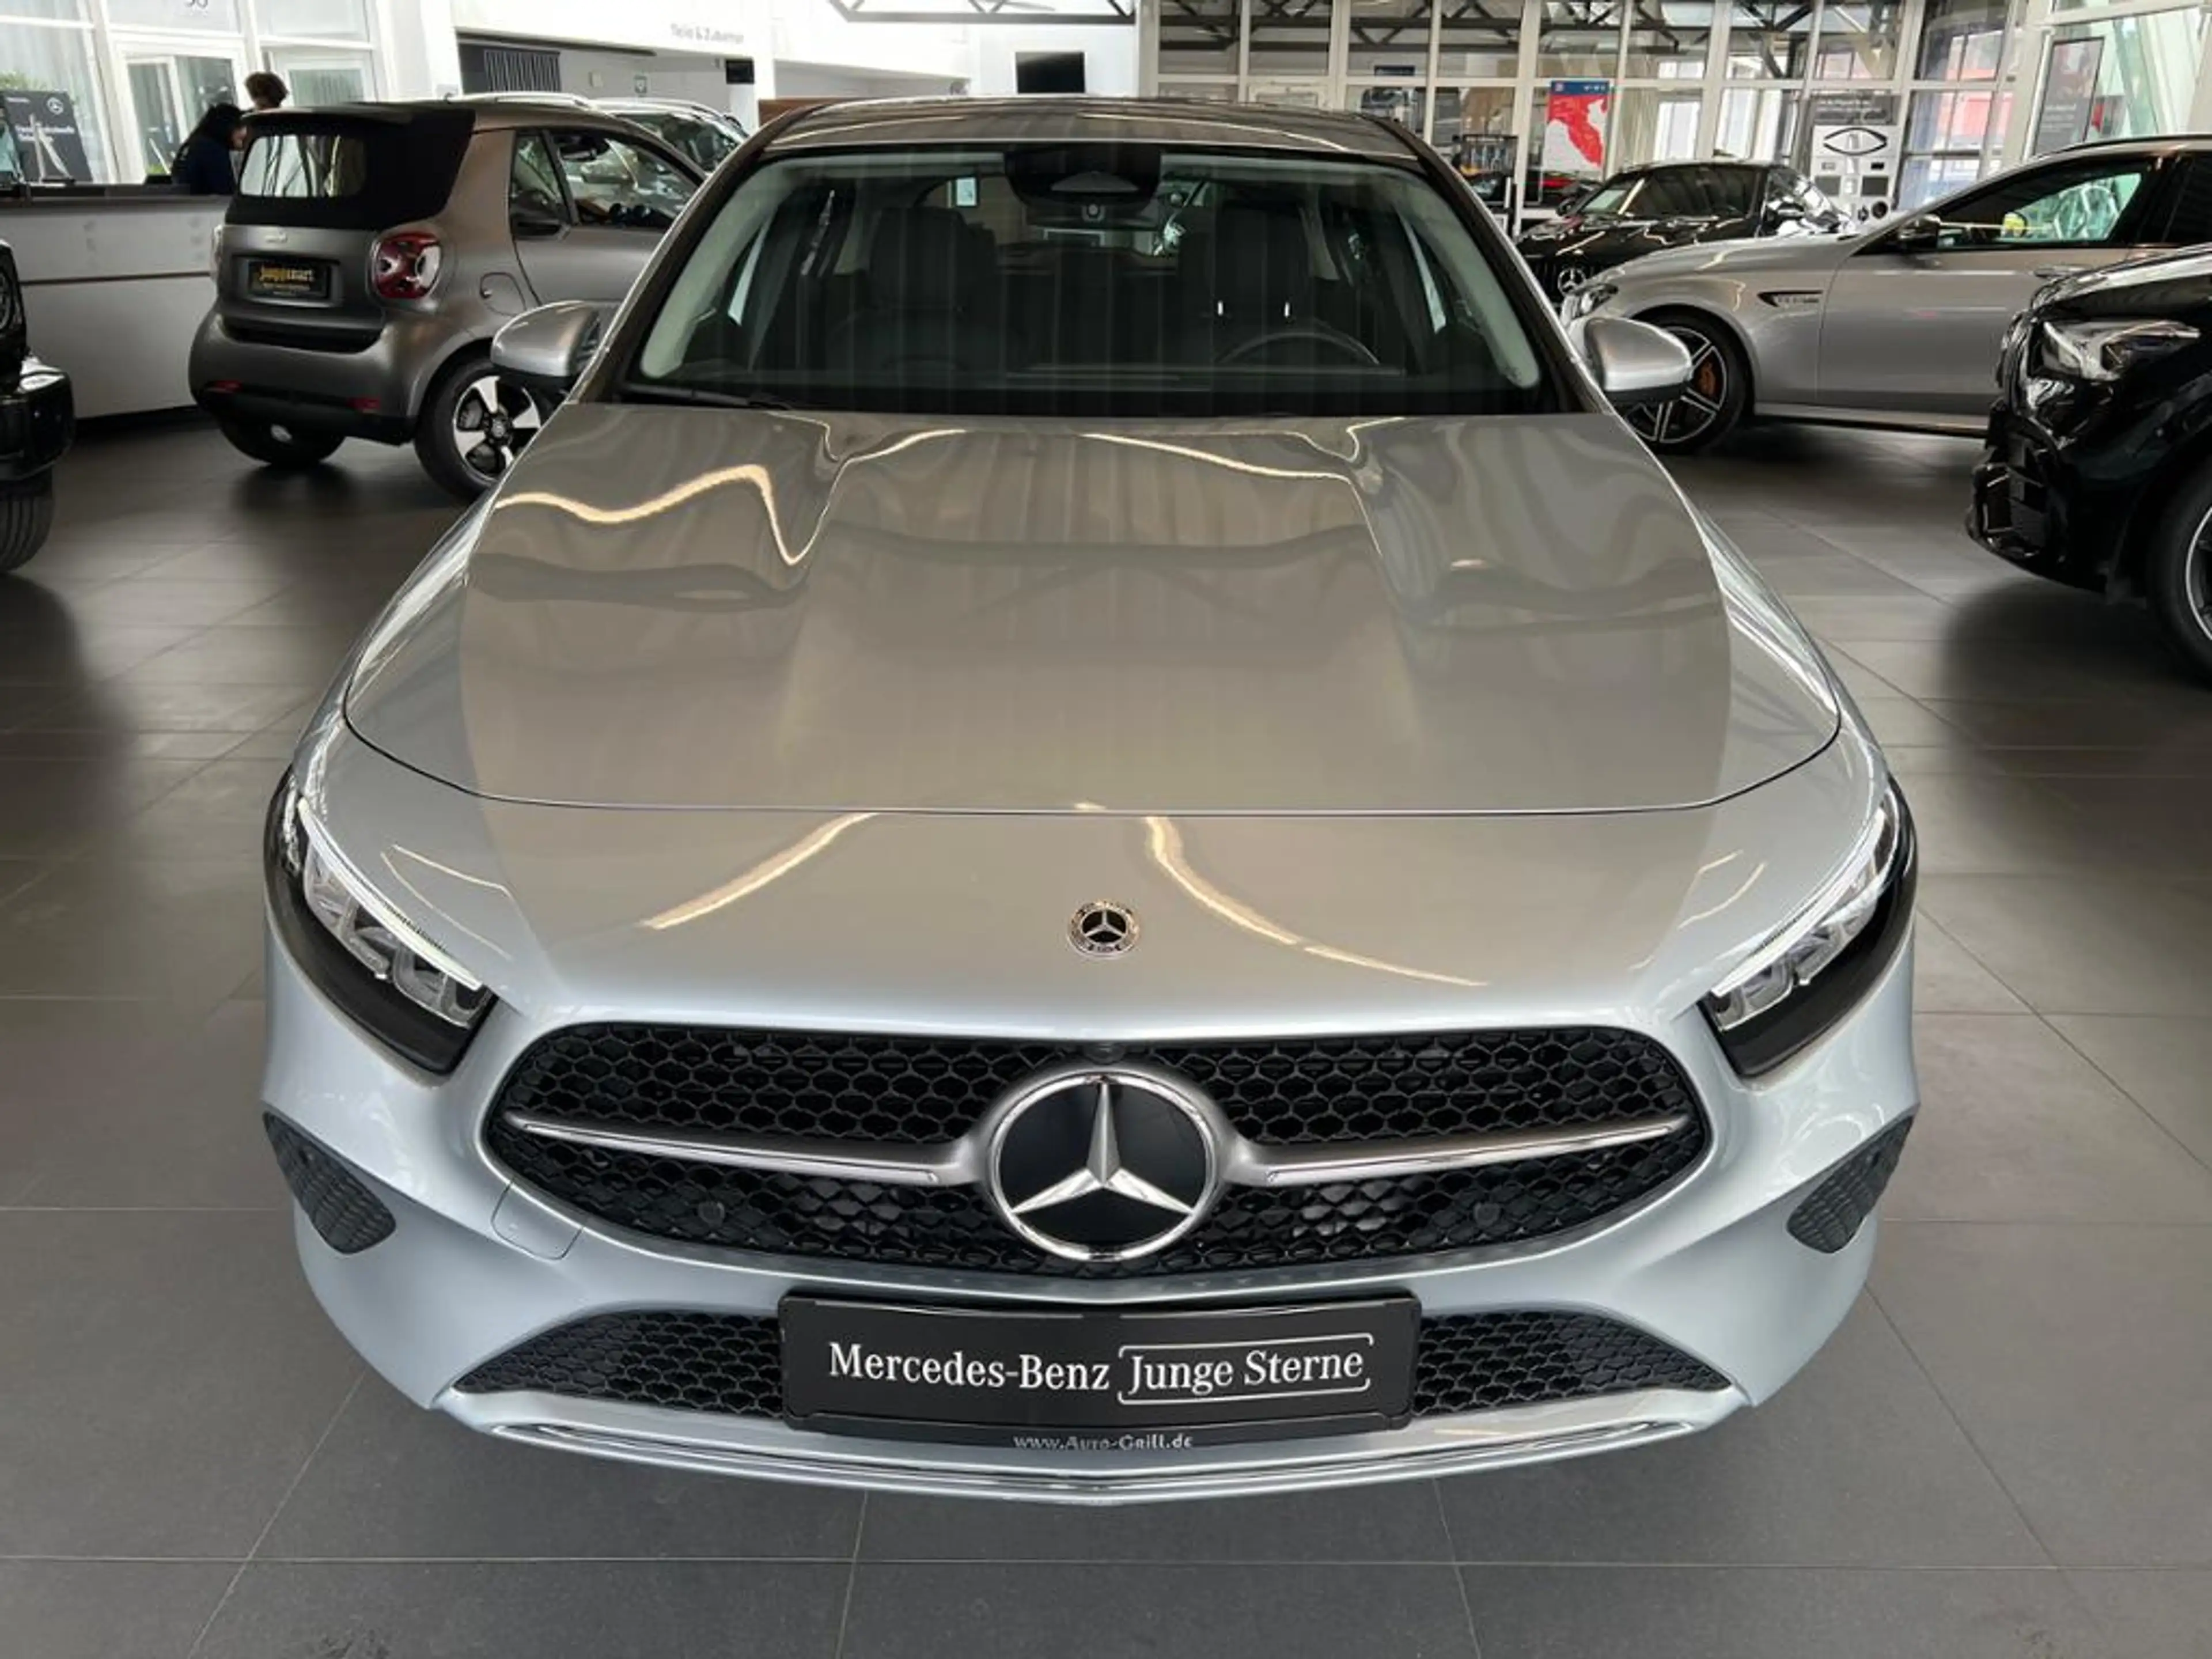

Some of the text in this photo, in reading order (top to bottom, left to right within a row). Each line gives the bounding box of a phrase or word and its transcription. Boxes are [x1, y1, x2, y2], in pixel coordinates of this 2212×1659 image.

[828, 1342, 1364, 1396] Mercedes-Benz Junge Sterne
